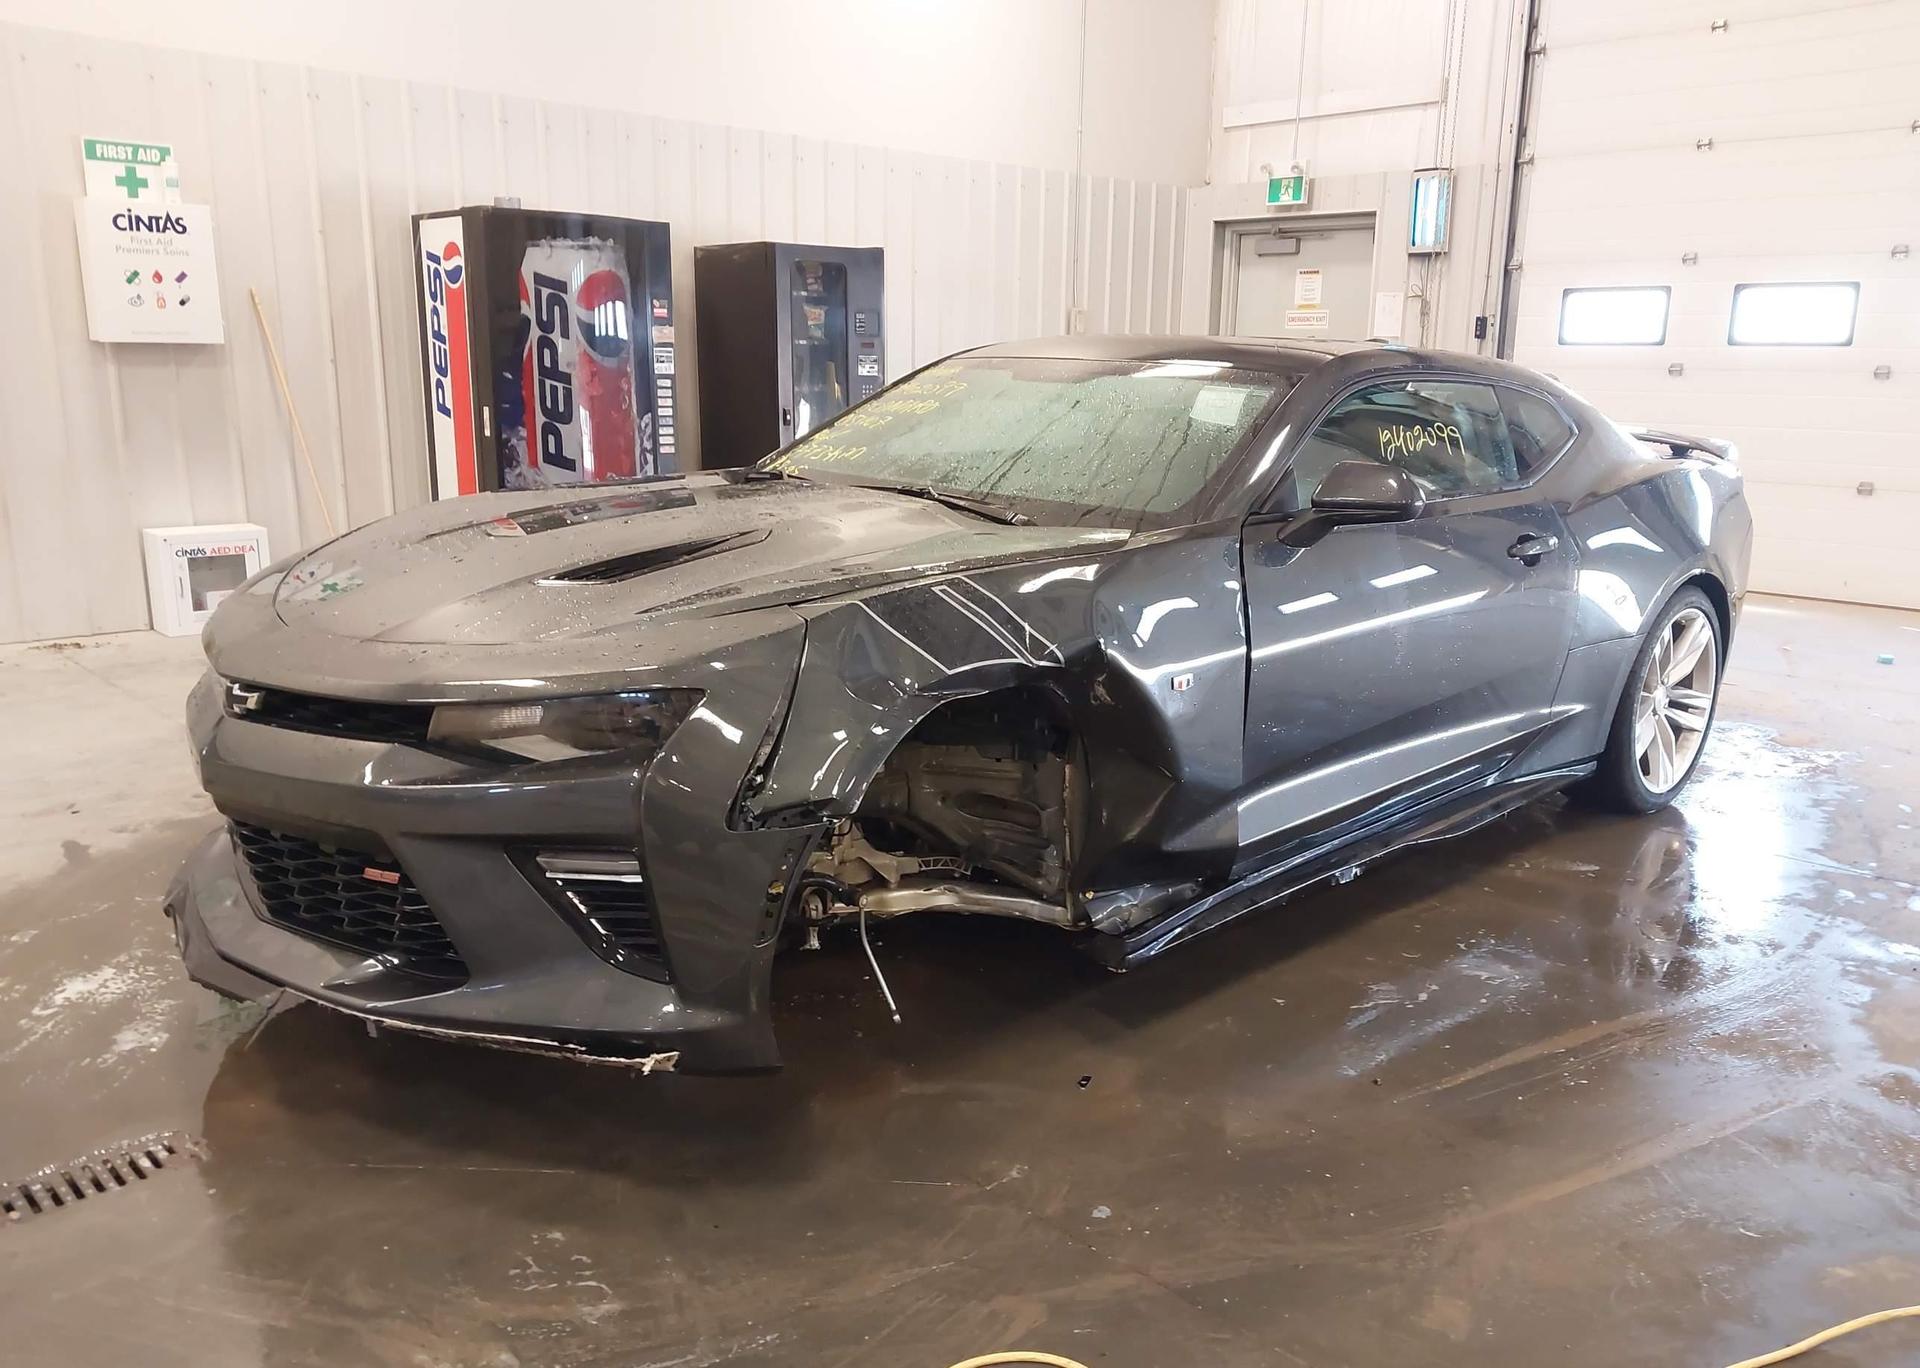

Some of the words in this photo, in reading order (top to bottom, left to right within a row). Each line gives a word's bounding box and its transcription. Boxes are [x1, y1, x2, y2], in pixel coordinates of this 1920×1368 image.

[95, 143, 132, 160] FIRST
[137, 149, 161, 163] AID
[130, 236, 153, 246] First
[156, 237, 174, 247] Aid
[115, 245, 161, 256] Premiers
[163, 247, 190, 257] Soins
[426, 250, 452, 420] PEPSI
[534, 272, 577, 472] PEPSI
[210, 546, 231, 555] AED
[234, 545, 256, 554] DEA
